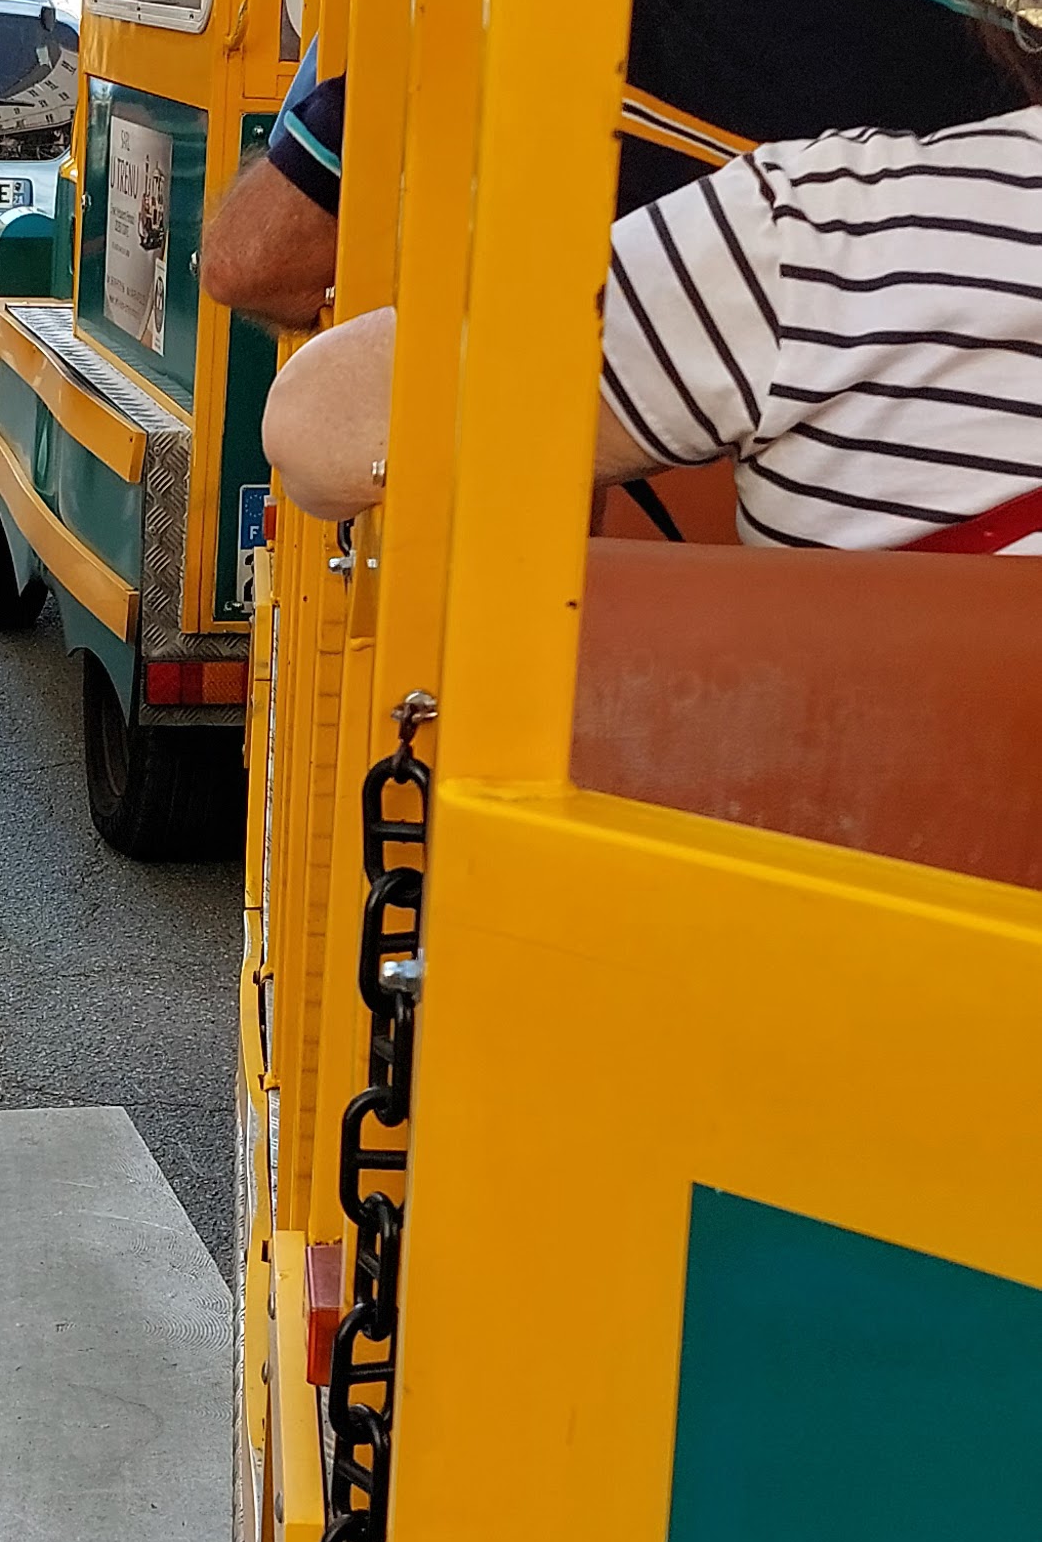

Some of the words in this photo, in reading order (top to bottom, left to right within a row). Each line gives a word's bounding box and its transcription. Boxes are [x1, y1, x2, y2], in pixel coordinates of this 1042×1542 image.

[110, 156, 116, 188] U
[117, 157, 139, 200] TRENU
[249, 525, 260, 540] F
